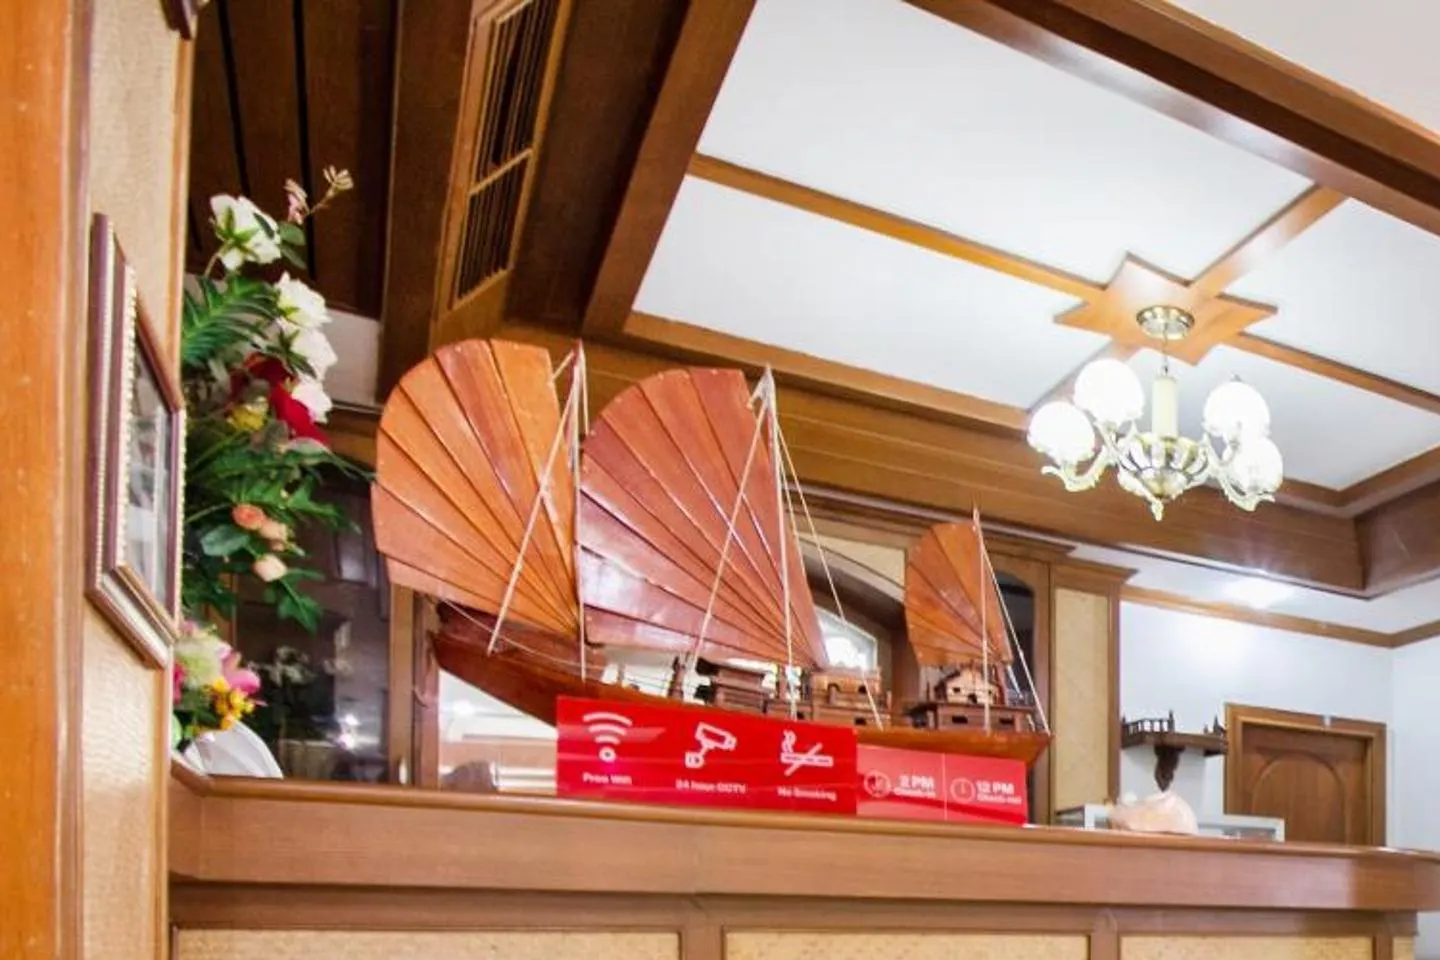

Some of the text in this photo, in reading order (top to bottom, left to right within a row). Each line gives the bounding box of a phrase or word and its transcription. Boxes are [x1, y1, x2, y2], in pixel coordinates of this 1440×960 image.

[911, 776, 935, 790] PM
[975, 780, 1015, 795] 12 PM
[777, 786, 794, 798] No
